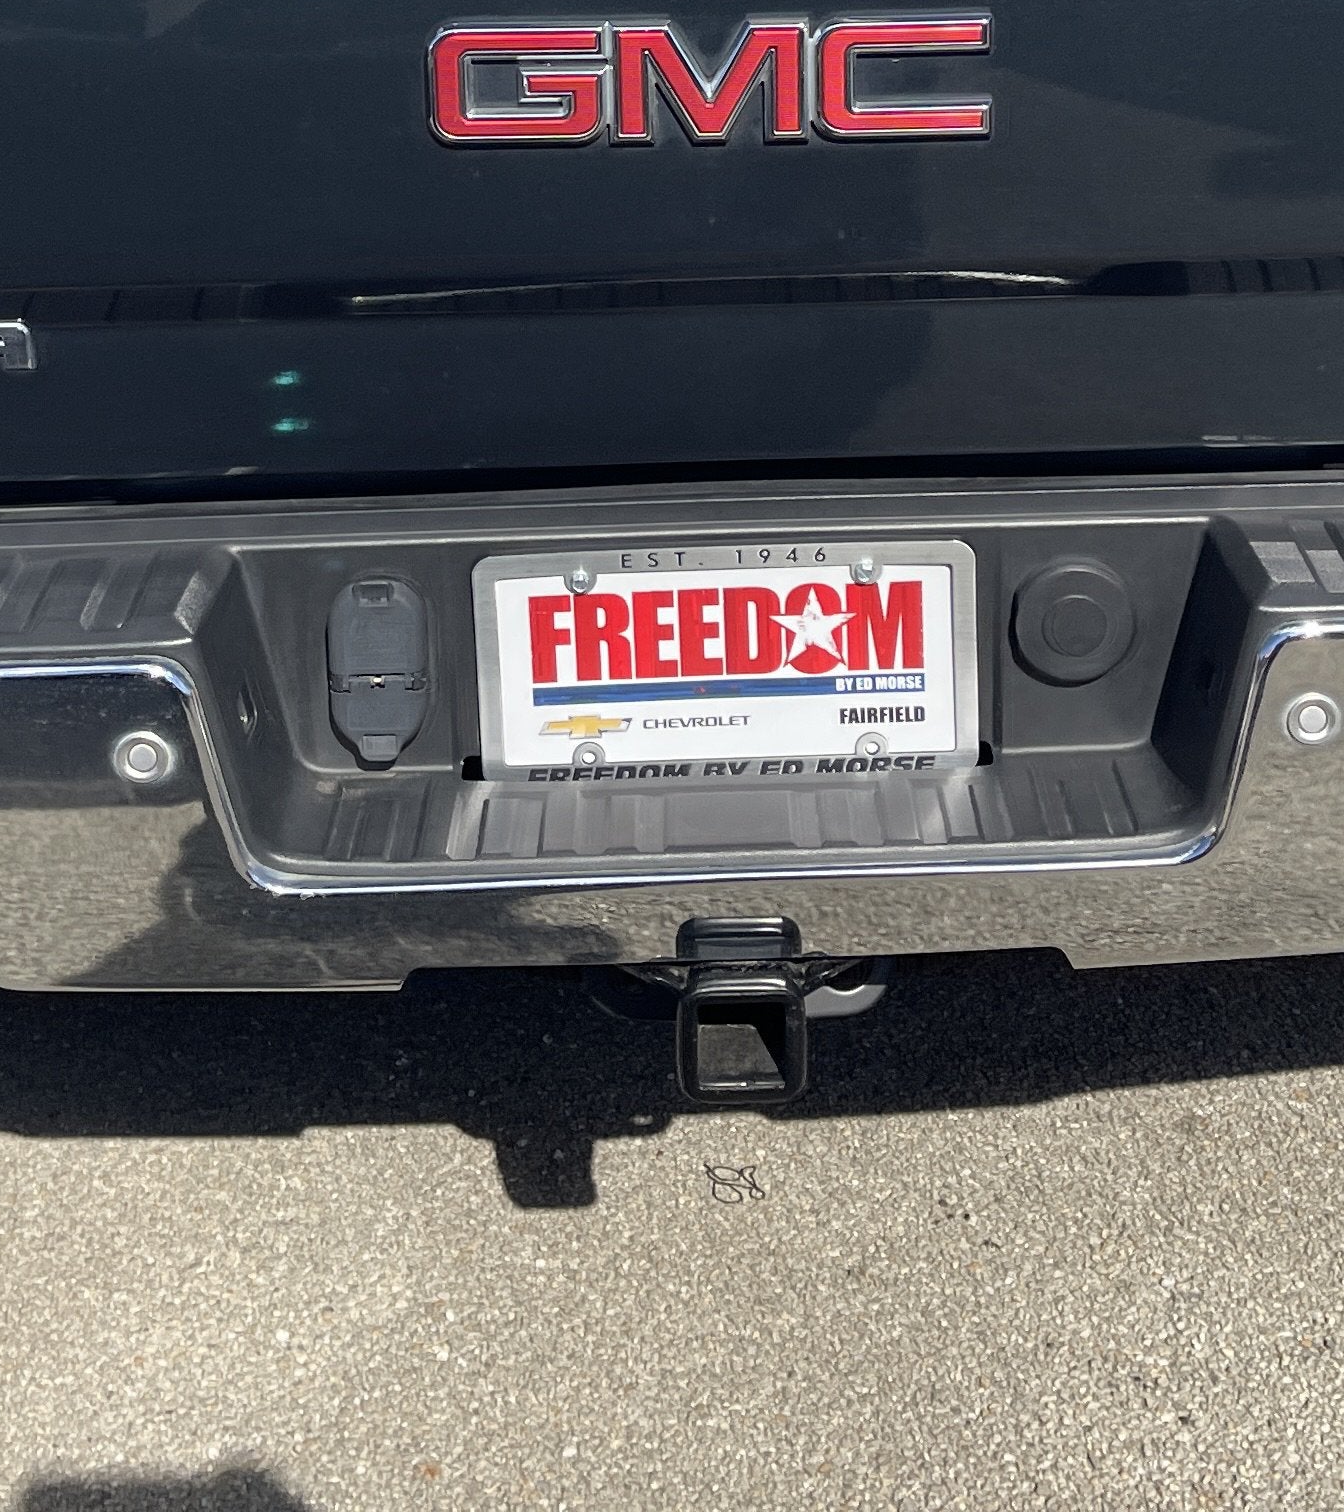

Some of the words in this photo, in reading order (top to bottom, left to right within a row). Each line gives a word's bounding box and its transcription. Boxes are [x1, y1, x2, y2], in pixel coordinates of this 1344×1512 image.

[427, 13, 991, 144] GMC
[622, 551, 712, 569] EST.
[735, 547, 827, 567] 1946
[528, 581, 925, 683] FREEDOM
[836, 679, 852, 691] BY
[856, 678, 873, 690] ED
[875, 675, 923, 689] MORSE
[643, 715, 751, 729] CHEVROLET
[839, 706, 925, 724] FAIRFIELD
